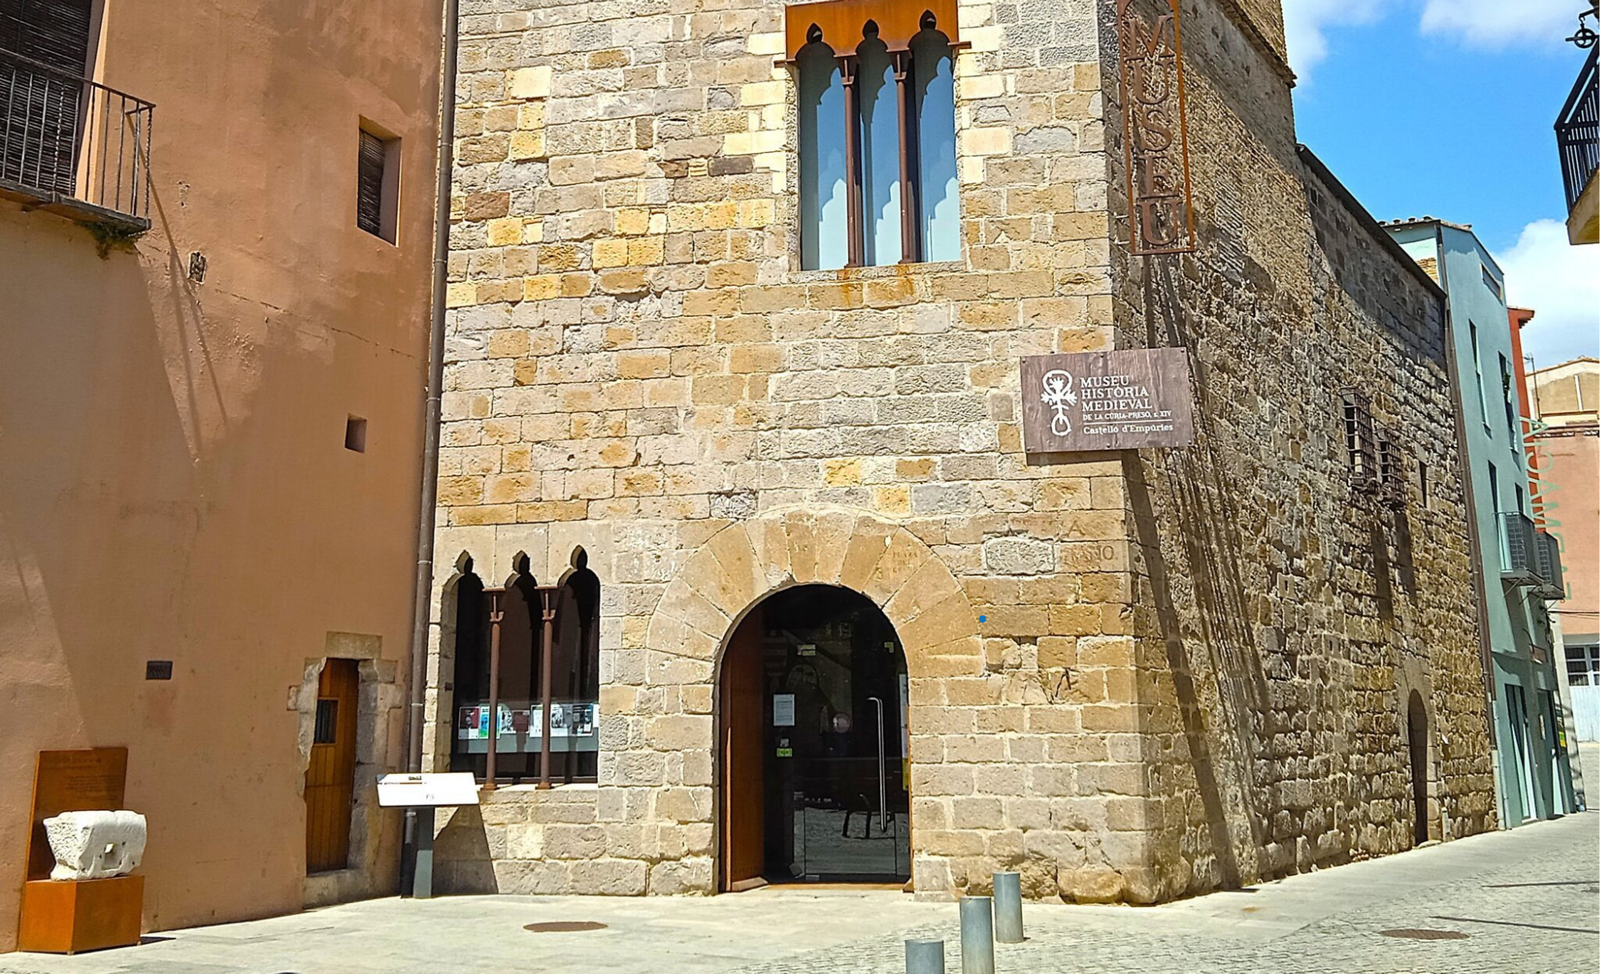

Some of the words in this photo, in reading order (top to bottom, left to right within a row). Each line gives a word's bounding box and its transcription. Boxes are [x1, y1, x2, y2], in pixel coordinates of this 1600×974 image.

[1124, 15, 1184, 246] MUSEU
[1080, 375, 1129, 388] MUSEU
[1081, 385, 1149, 399] HISTÒRIA
[1082, 398, 1152, 412] MEDIEVAL
[1083, 425, 1119, 435] Castelló
[1122, 423, 1174, 434] d'Empúries
